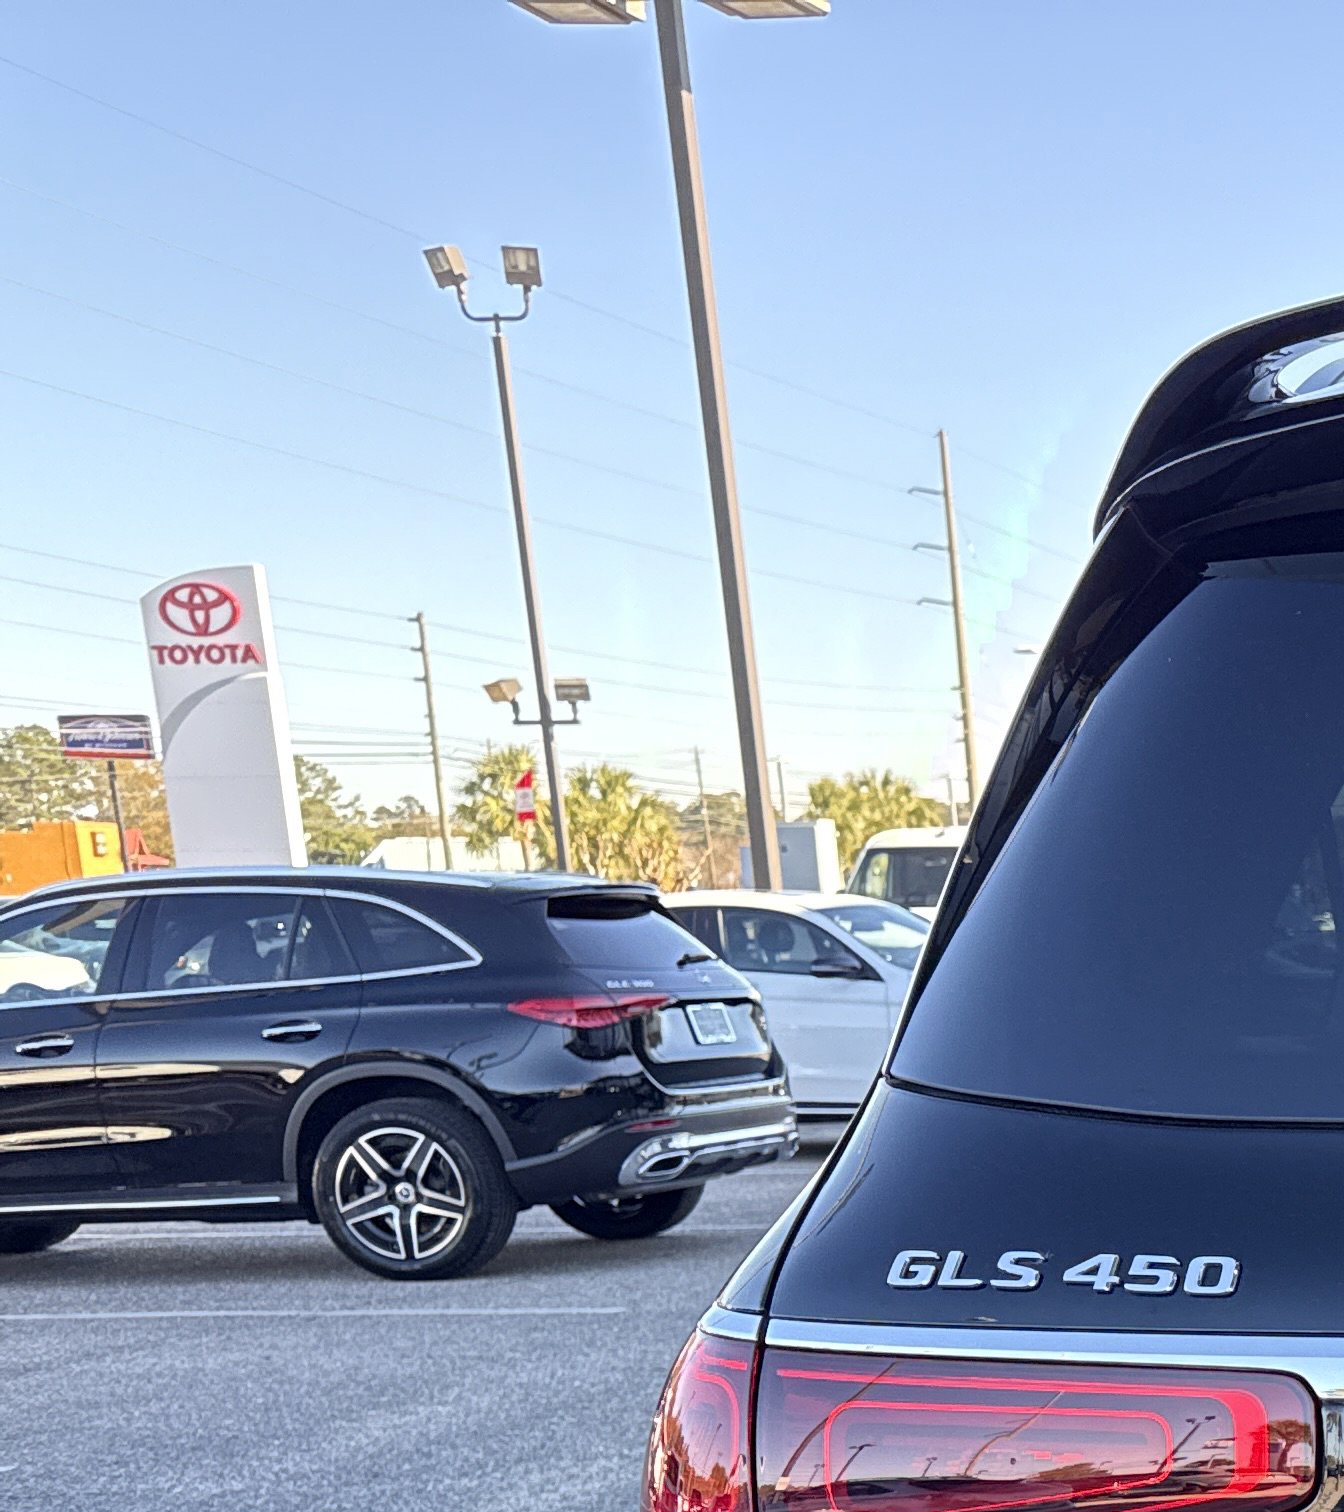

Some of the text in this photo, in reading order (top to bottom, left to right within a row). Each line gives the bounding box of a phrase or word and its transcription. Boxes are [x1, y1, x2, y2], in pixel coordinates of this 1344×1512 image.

[151, 644, 263, 665] TOYOTA
[886, 1250, 1241, 1296] GLS 450
